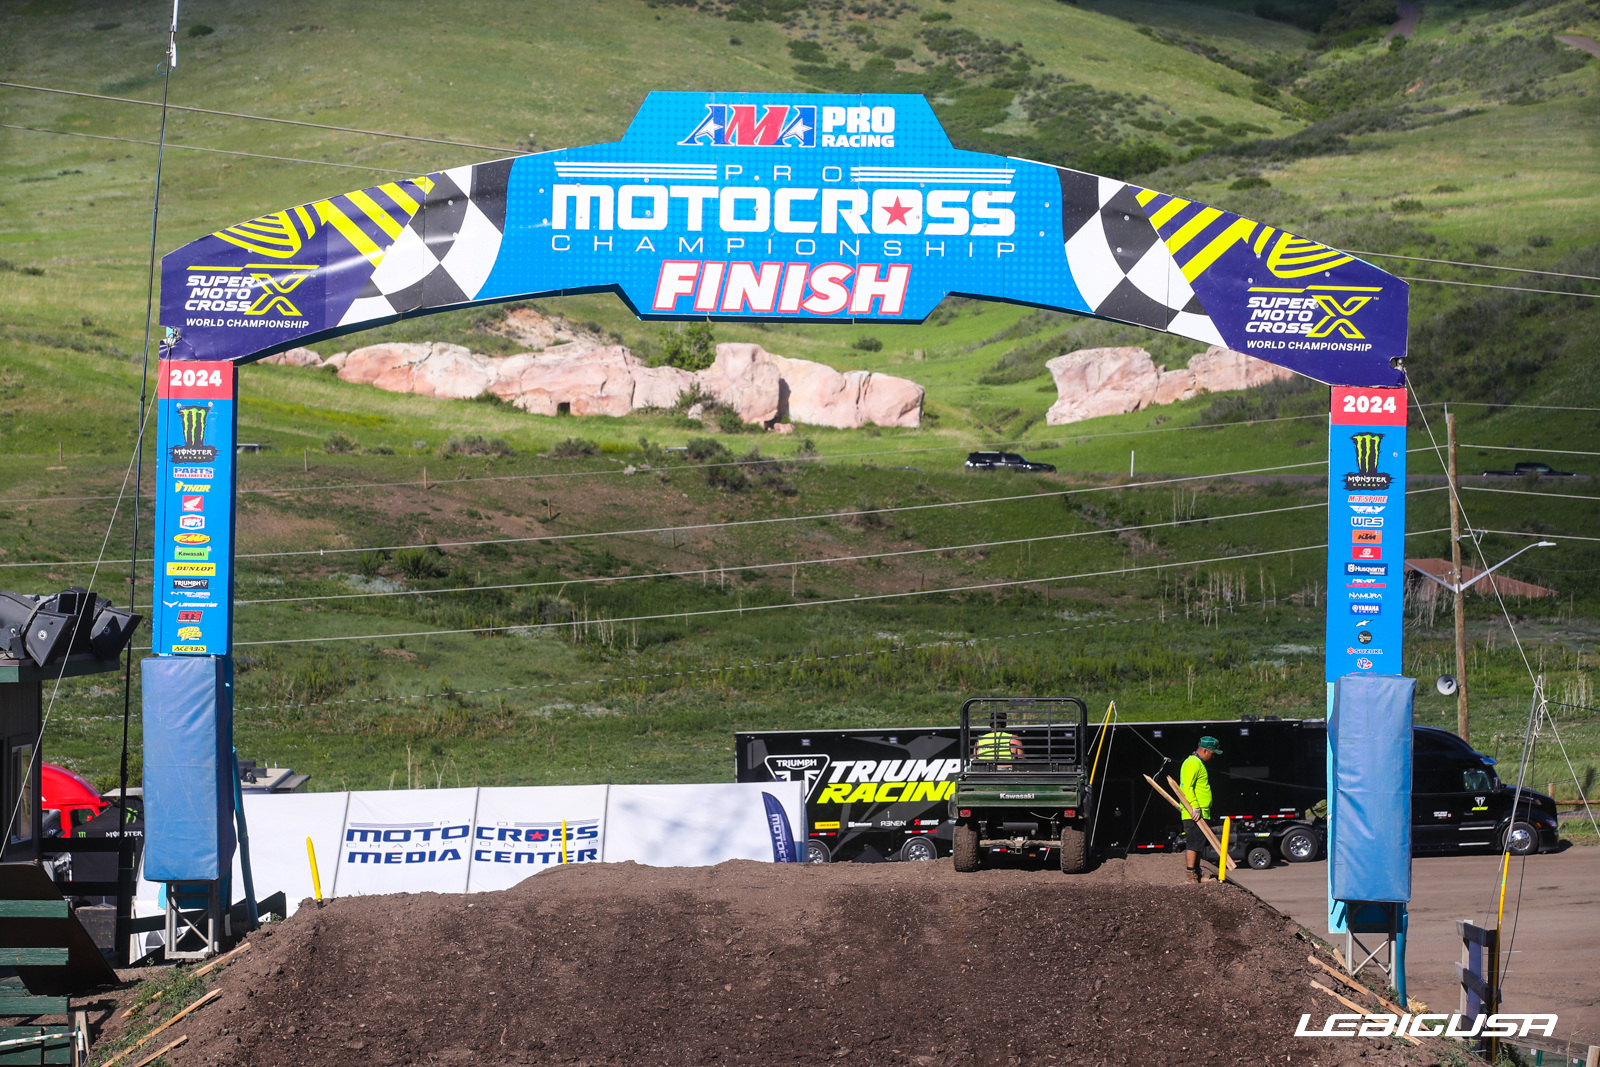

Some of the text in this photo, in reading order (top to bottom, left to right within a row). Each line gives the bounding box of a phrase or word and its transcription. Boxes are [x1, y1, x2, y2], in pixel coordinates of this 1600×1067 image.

[677, 104, 817, 147] AMA
[822, 106, 895, 133] PRO
[822, 134, 895, 148] RACING
[725, 165, 842, 182] PRO
[551, 184, 1016, 236] MOTOCROSS
[551, 234, 1015, 258] CHAMPIONSHIP
[186, 275, 257, 287] SUPER
[190, 288, 251, 299] MOTO
[652, 260, 912, 315] FINISH
[185, 300, 252, 312] CROSS
[1246, 297, 1318, 309] SUPER
[1251, 309, 1313, 322] MOTO
[186, 318, 309, 328] WORLD CHAMPIONSHIP
[1245, 322, 1314, 334] CROSS
[1247, 340, 1372, 351] WORLD CHAMPIONSHIP
[170, 369, 222, 386] 2024
[1343, 395, 1396, 413] 2024
[174, 448, 212, 456] MONSTER
[1347, 475, 1387, 483] MONSTER
[183, 484, 211, 492] THOR
[183, 518, 202, 527] 100%
[1351, 516, 1384, 527] WPS
[174, 580, 201, 588] TRIUMPH
[178, 611, 202, 619] ETS
[776, 759, 817, 770] TRIUMPH
[828, 759, 961, 783] TRIUMP
[347, 849, 462, 864] MEDIA
[474, 848, 597, 864] CENTER
